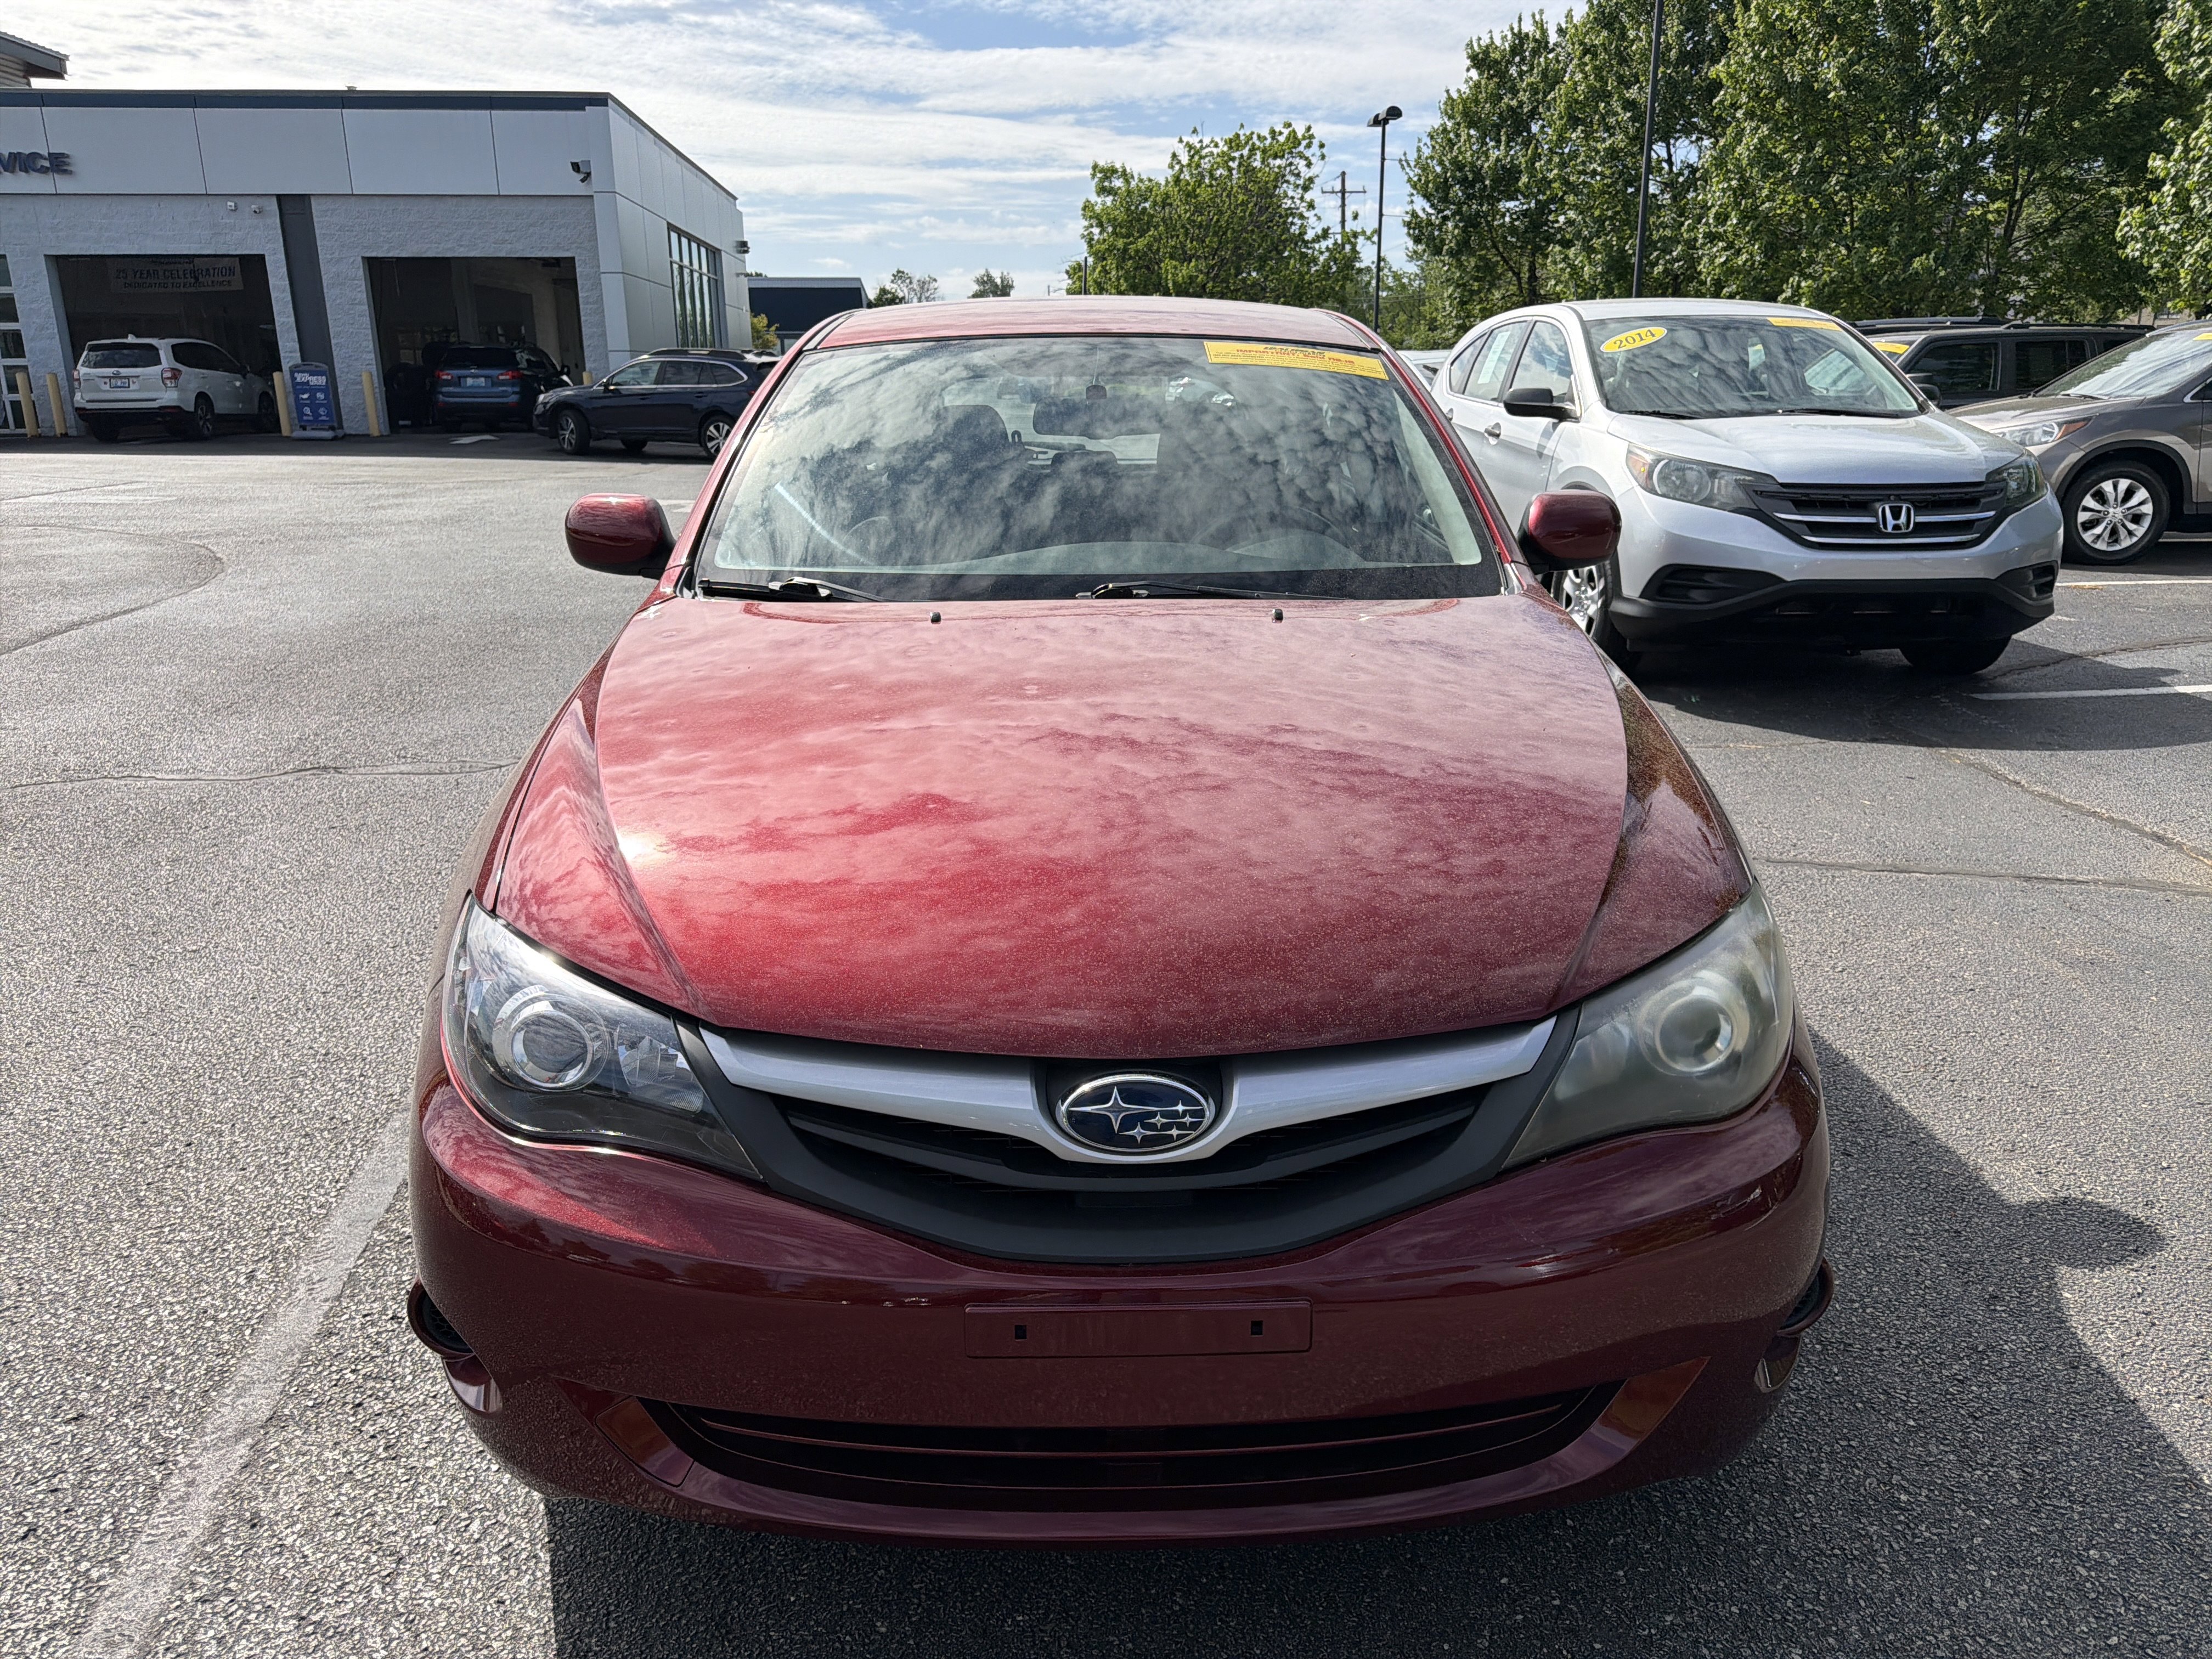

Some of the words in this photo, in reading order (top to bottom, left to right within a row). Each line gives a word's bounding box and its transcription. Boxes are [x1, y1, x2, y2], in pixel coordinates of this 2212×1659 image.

[132, 268, 159, 280] YEAR
[162, 266, 236, 280] CELEBRATION
[1613, 329, 1656, 349] 2014
